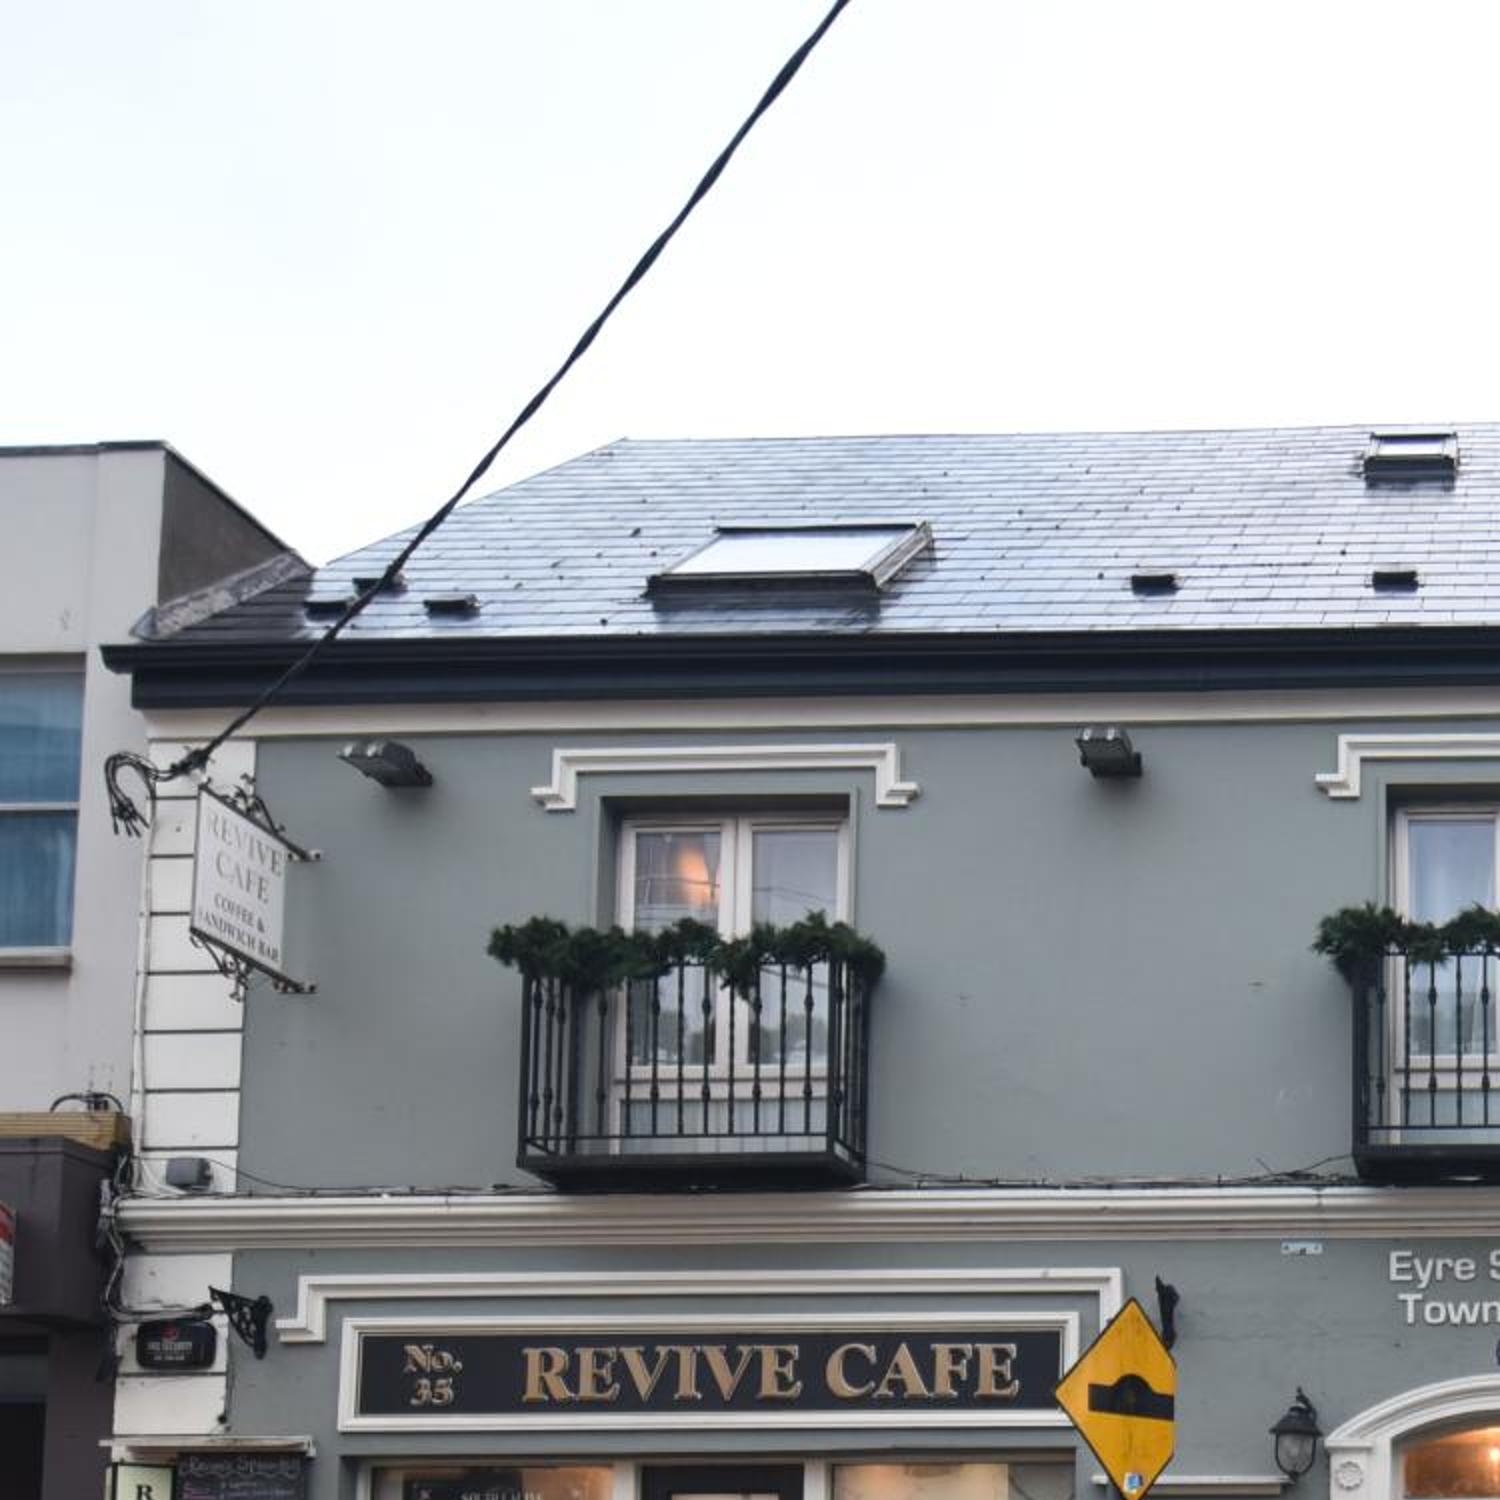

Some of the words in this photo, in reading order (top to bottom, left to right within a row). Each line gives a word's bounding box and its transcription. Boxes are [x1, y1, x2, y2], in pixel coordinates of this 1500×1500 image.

[207, 813, 282, 877] REVIVE
[215, 850, 269, 904] CAFE
[214, 893, 254, 927] COFFEE
[257, 917, 266, 934] &
[259, 938, 279, 962] BAR
[1389, 1250, 1477, 1289] Eyre
[403, 1344, 464, 1373] No.
[521, 1344, 803, 1402] REVIVE
[824, 1342, 1021, 1399] CAFE
[410, 1377, 455, 1406] 35
